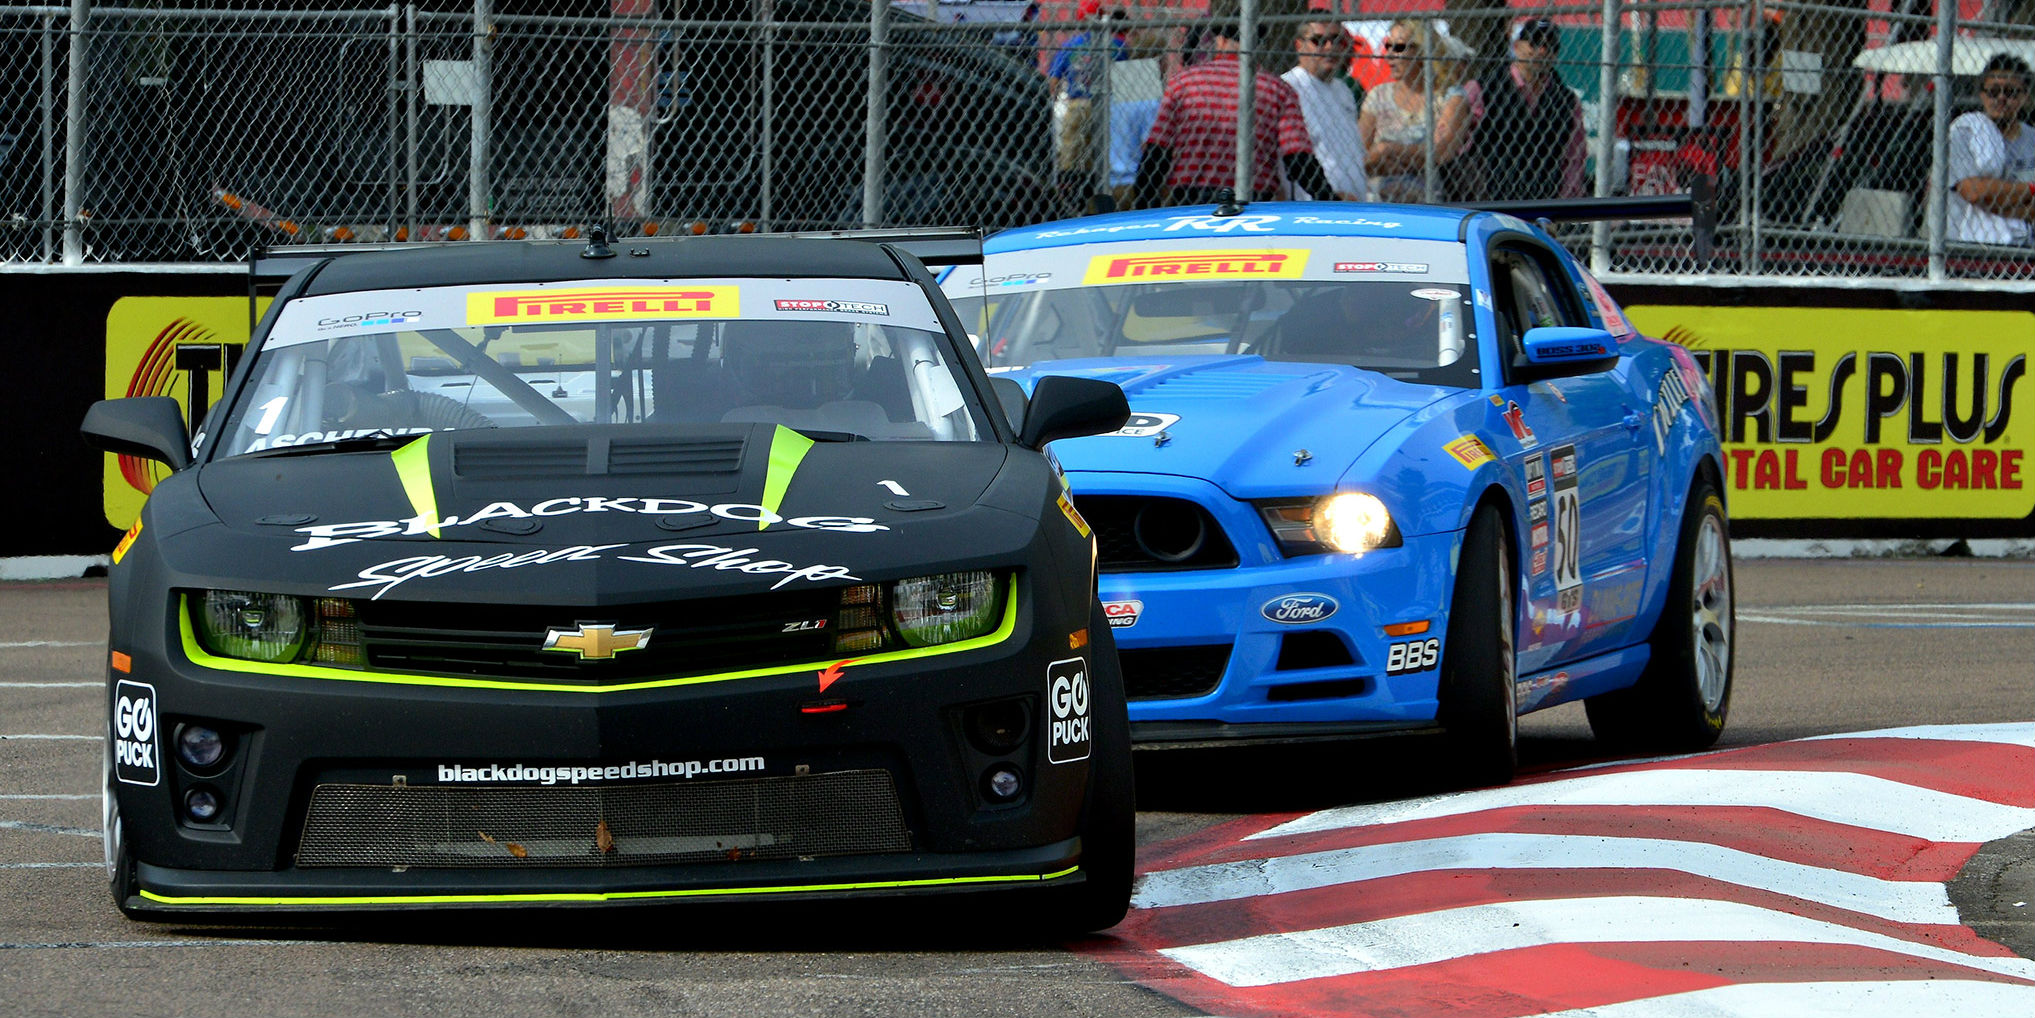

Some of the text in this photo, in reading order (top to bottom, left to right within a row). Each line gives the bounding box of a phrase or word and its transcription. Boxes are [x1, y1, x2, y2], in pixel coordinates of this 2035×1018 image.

[1162, 215, 1282, 233] RR
[1106, 254, 1288, 278] PIRELLI
[317, 310, 422, 326] GoPro
[494, 291, 715, 318] PIRELLI
[780, 301, 885, 312] STOP TECH
[1690, 350, 1857, 444] IRES
[1864, 351, 2026, 445] PLUS
[256, 396, 289, 435] 1
[1125, 414, 1164, 428] D
[1722, 447, 2024, 490] TAL CAR CARE
[291, 496, 891, 552] BLACKDOG
[328, 543, 863, 600] Speed Shop
[1105, 603, 1137, 616] CA
[1109, 617, 1135, 626] ING
[1276, 597, 1325, 621] Ford
[781, 618, 828, 633] ZL1
[1386, 638, 1440, 676] BBS
[1051, 670, 1089, 719] GO
[116, 695, 153, 742] GO
[1052, 715, 1090, 747] PUCK
[116, 738, 155, 770] PUCK
[437, 756, 765, 785] blackdogspeedshop.com
